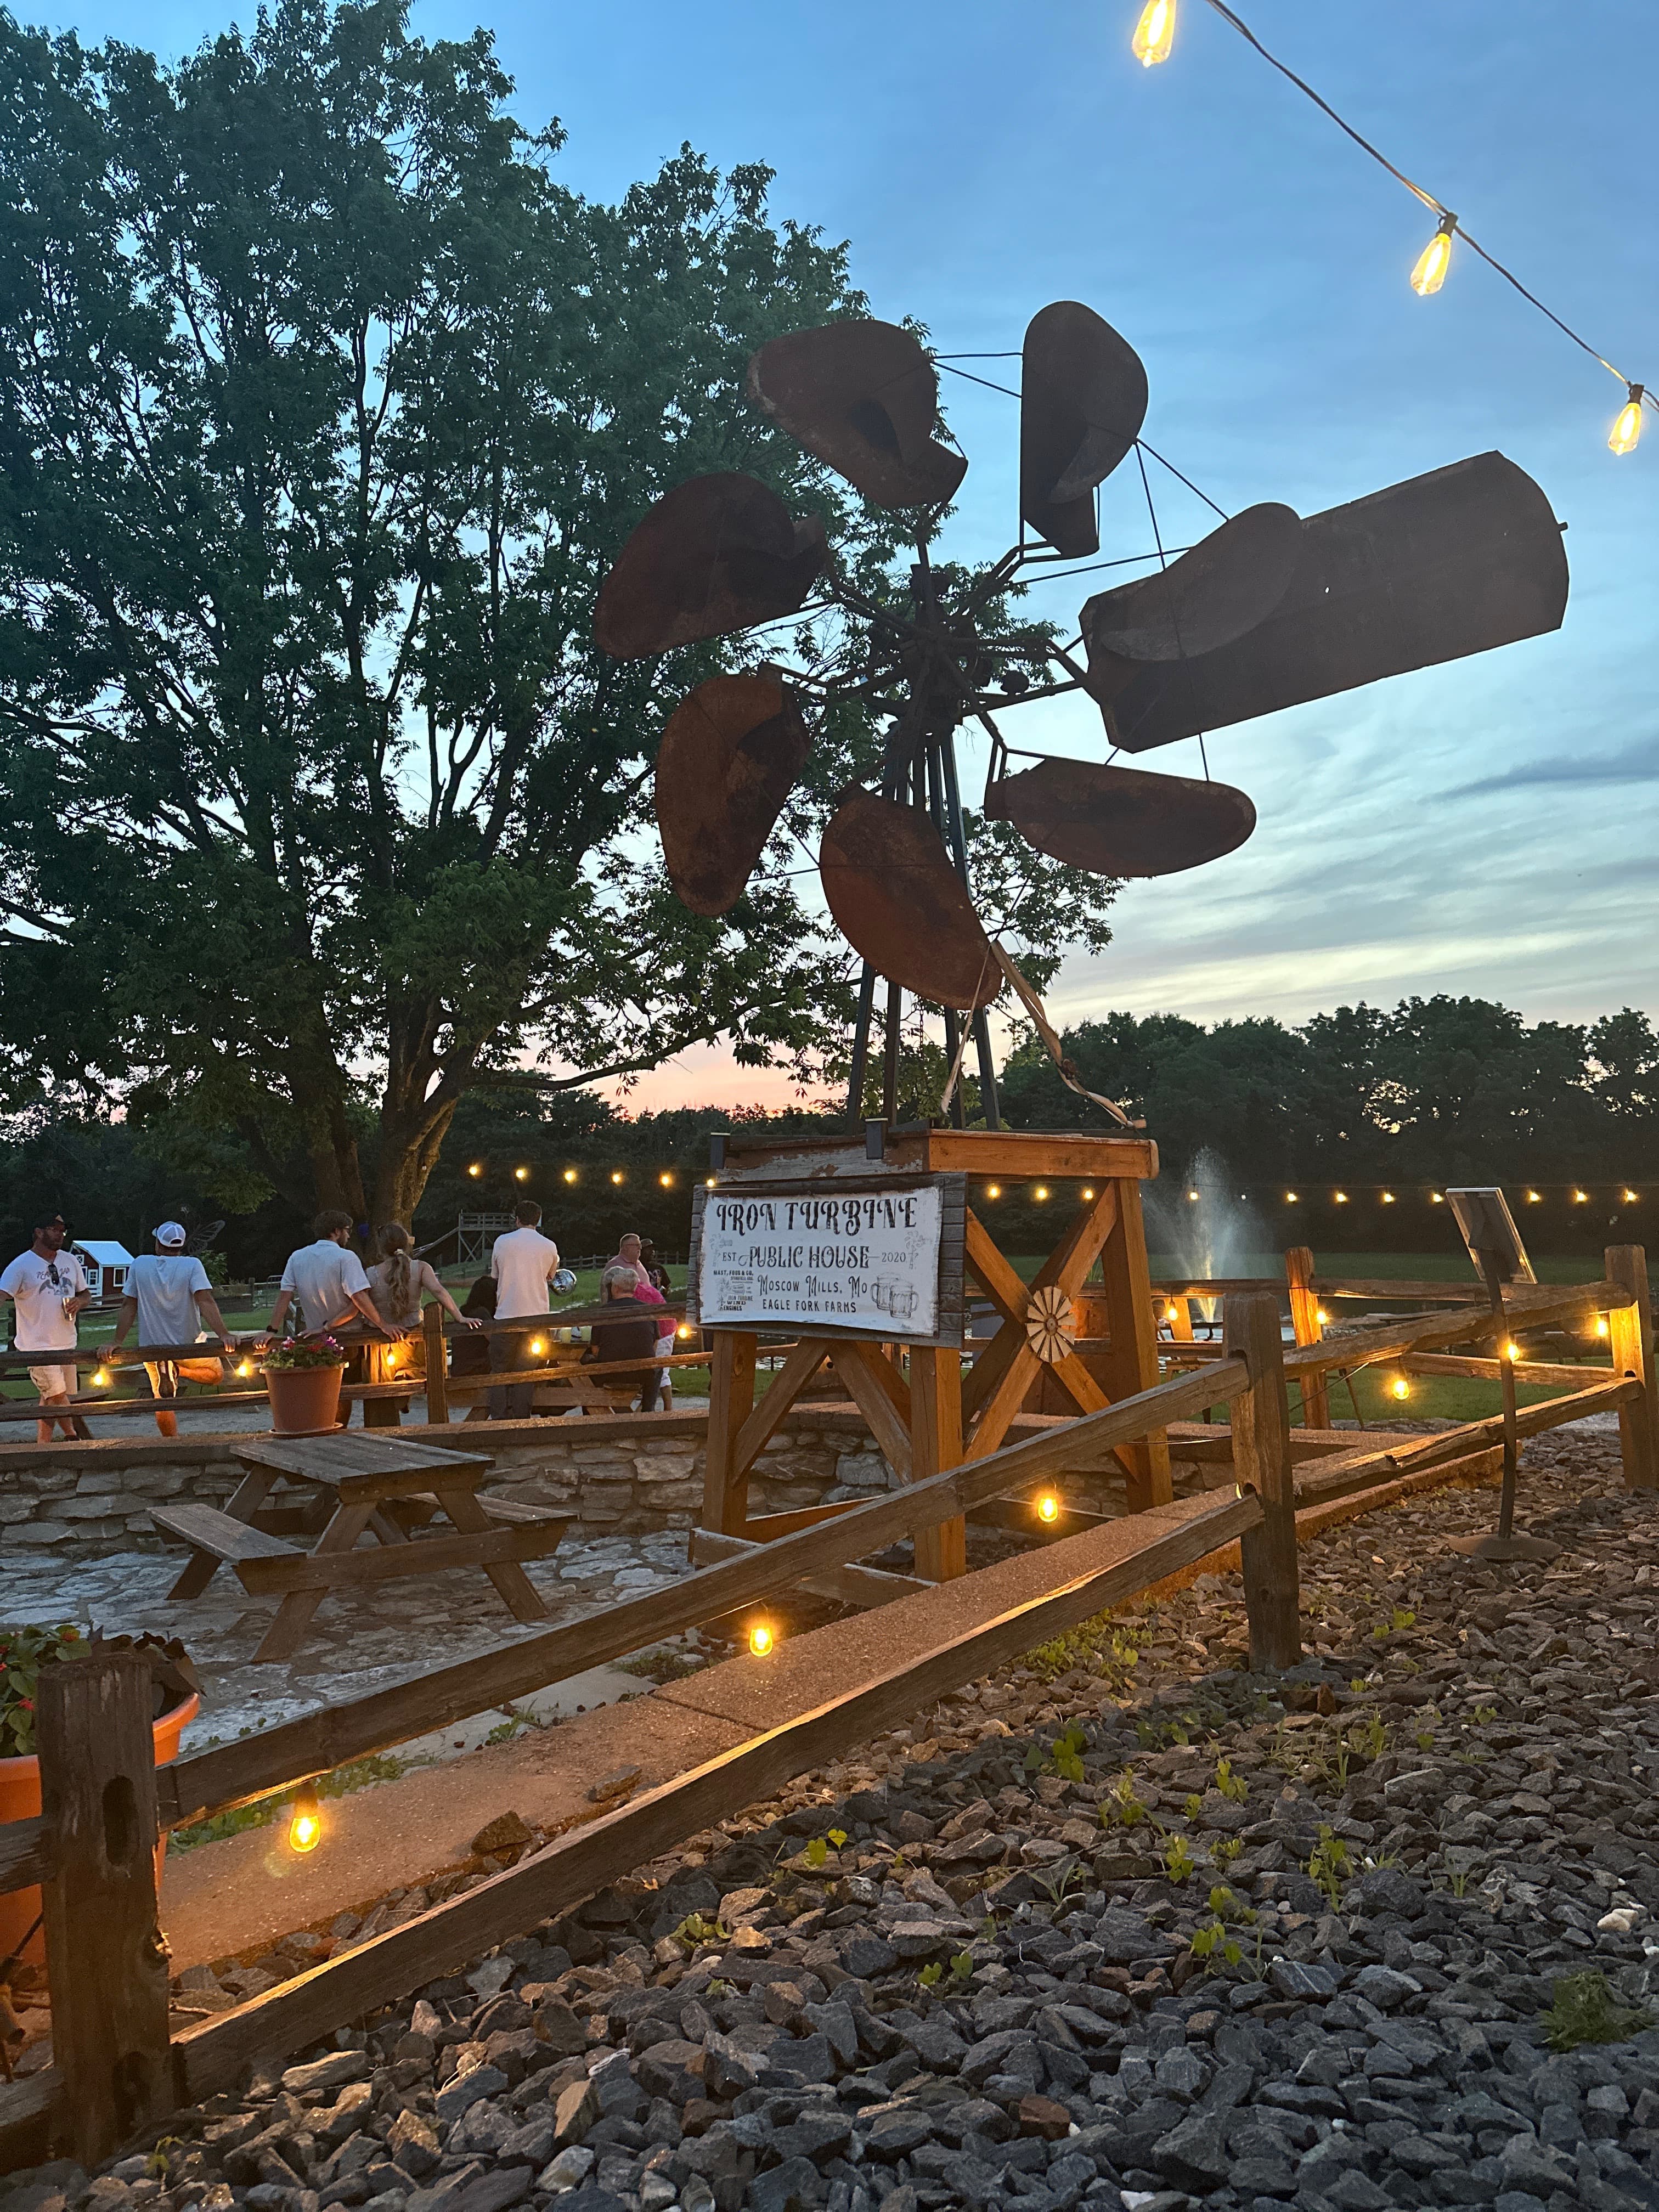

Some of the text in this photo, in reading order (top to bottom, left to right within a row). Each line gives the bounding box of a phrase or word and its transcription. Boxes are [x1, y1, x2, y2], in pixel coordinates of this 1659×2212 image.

[716, 1197, 917, 1236] IRON TURBINE
[723, 1246, 906, 1268] EST PUBLIC HOUSE 2020
[763, 1299, 856, 1313] EAGLE FORK FARMS
